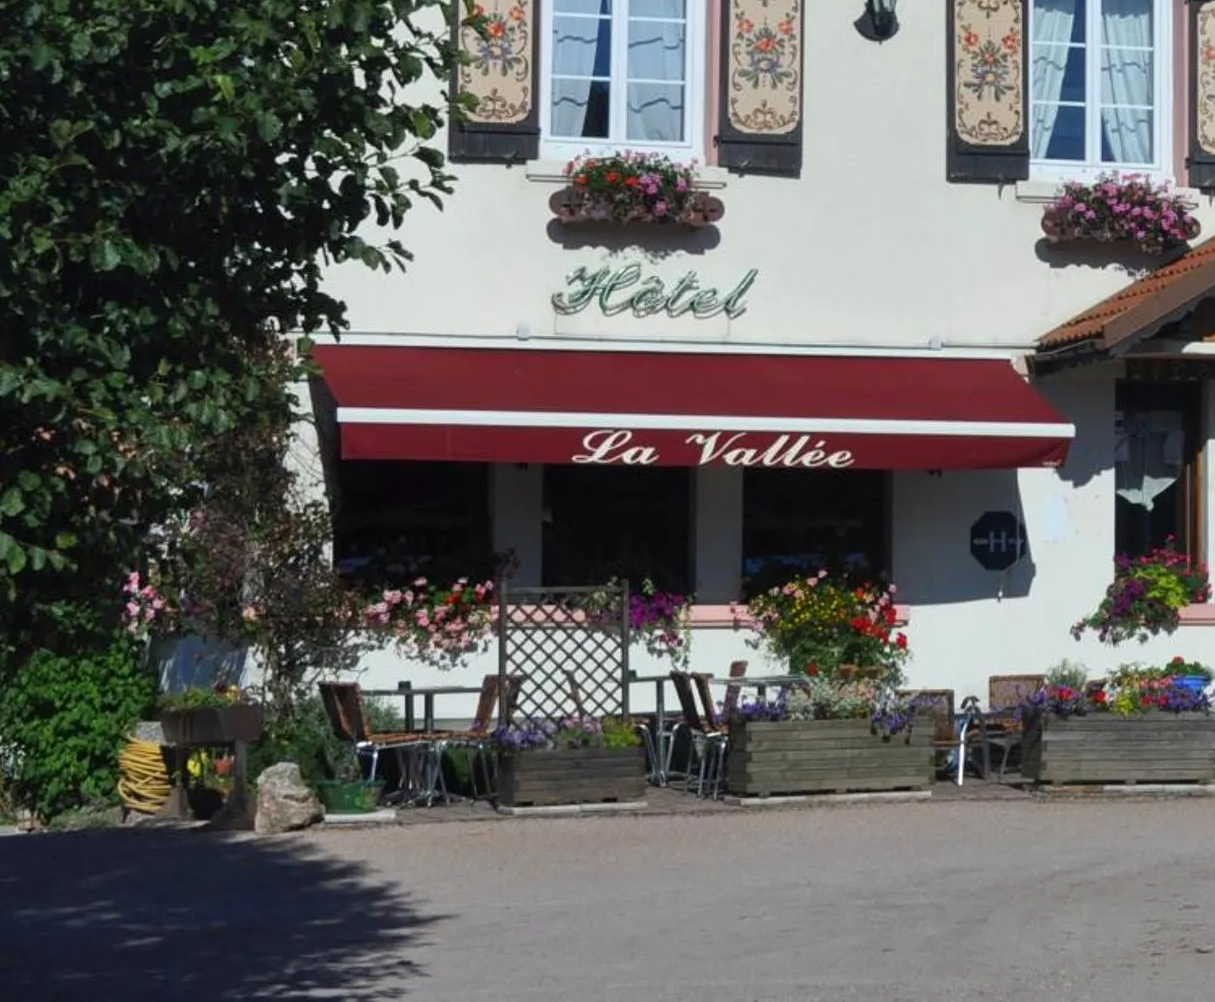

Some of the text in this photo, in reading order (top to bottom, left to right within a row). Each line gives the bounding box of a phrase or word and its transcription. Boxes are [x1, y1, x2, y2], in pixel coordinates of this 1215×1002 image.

[551, 263, 759, 320] Hôtel
[571, 429, 856, 469] La Vallée
